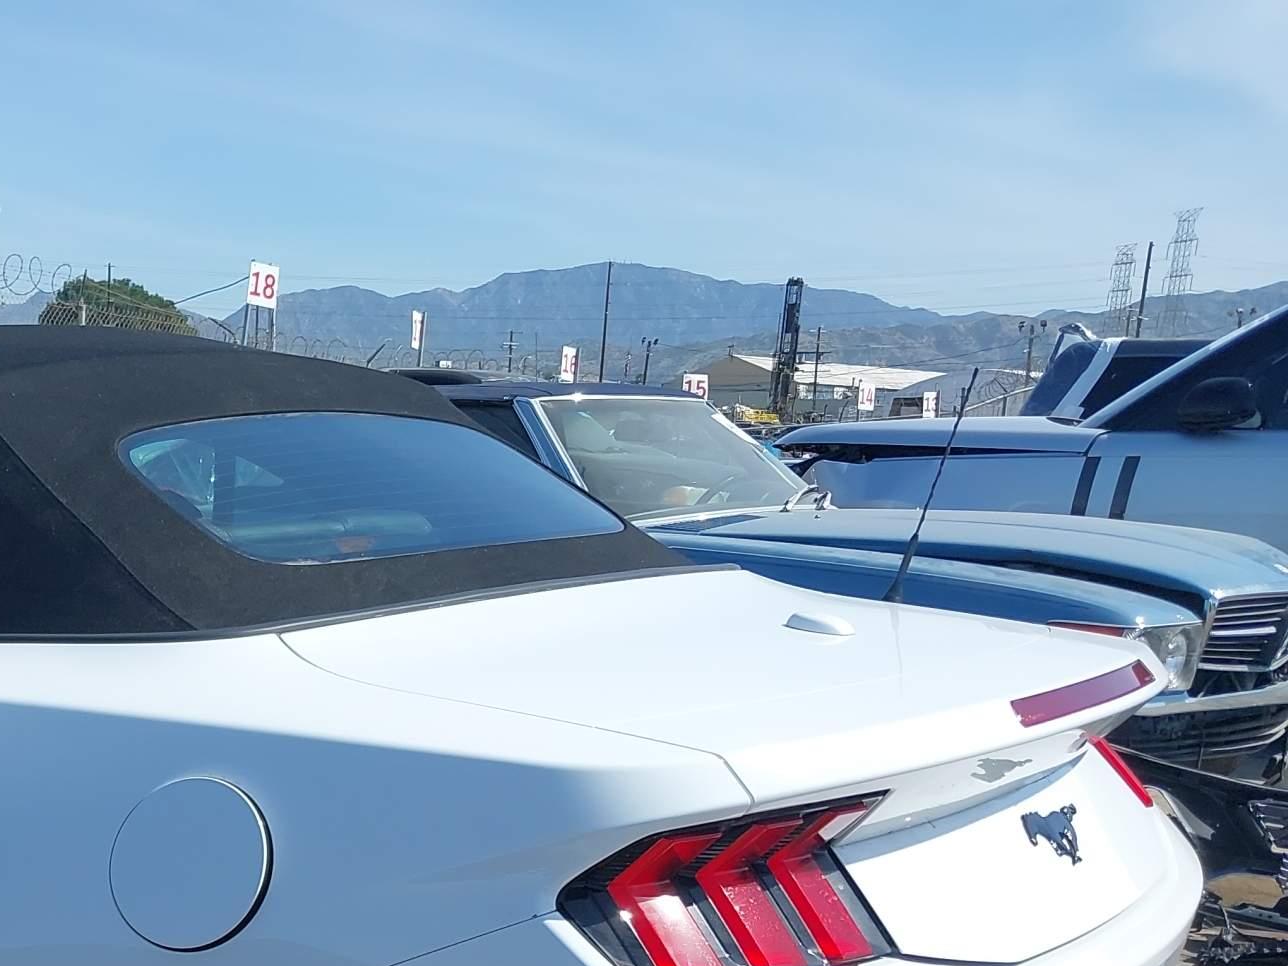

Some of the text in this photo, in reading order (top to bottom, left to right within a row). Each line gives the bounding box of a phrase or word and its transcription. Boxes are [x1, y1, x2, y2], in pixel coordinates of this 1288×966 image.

[249, 271, 275, 299] 18
[684, 379, 706, 398] 15
[859, 388, 873, 405] 14
